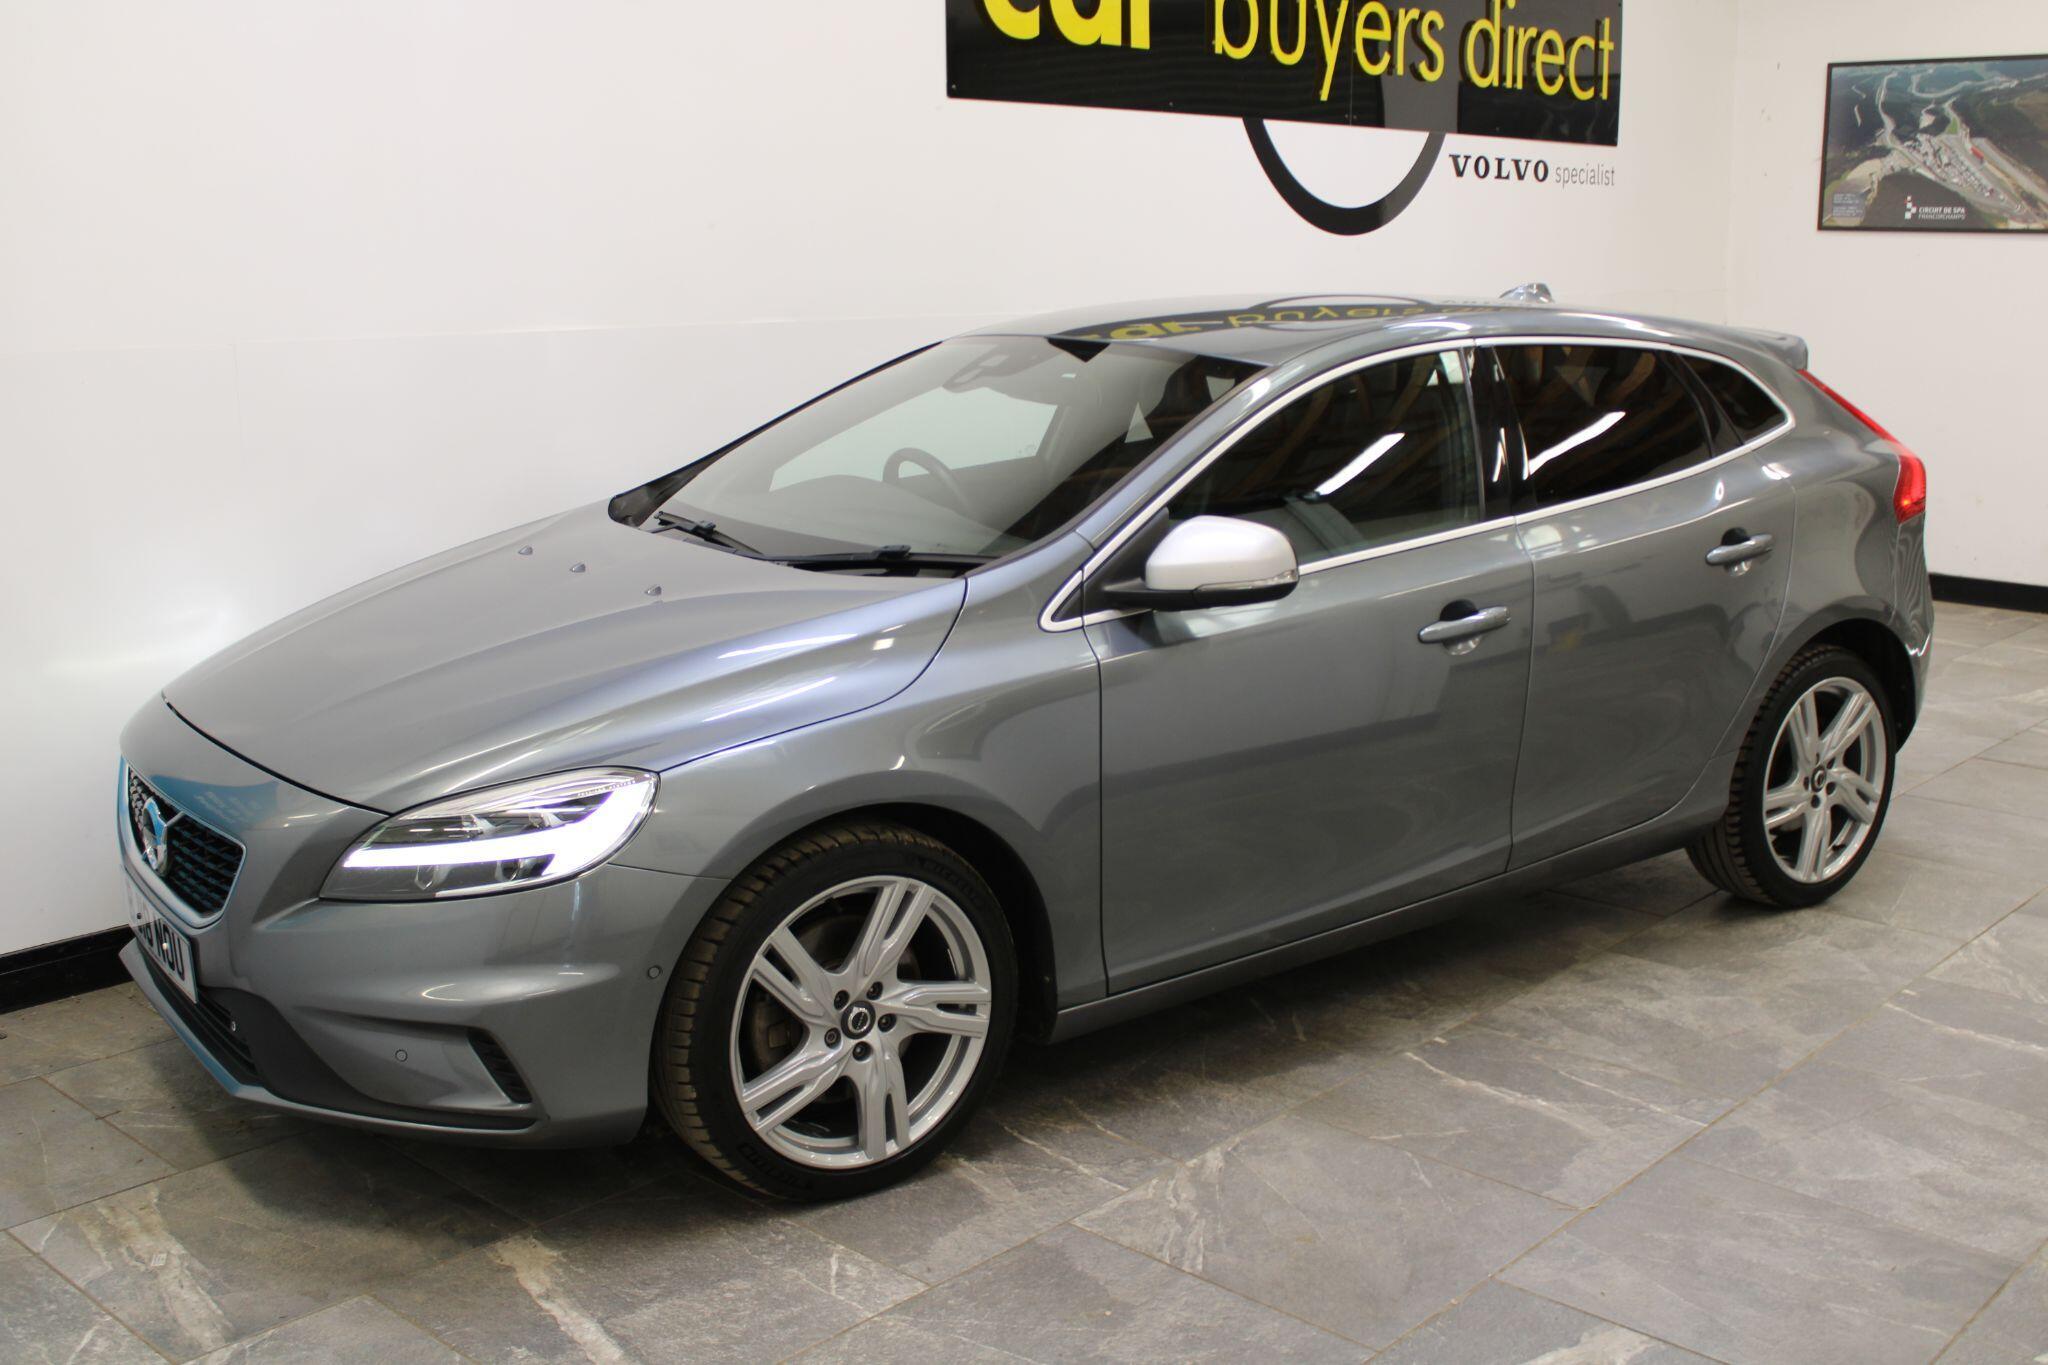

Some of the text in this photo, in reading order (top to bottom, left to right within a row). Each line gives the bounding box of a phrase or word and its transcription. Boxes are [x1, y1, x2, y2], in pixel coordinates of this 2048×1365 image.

[1467, 0, 1615, 101] direct
[1449, 154, 1616, 188] VOLVO specialist
